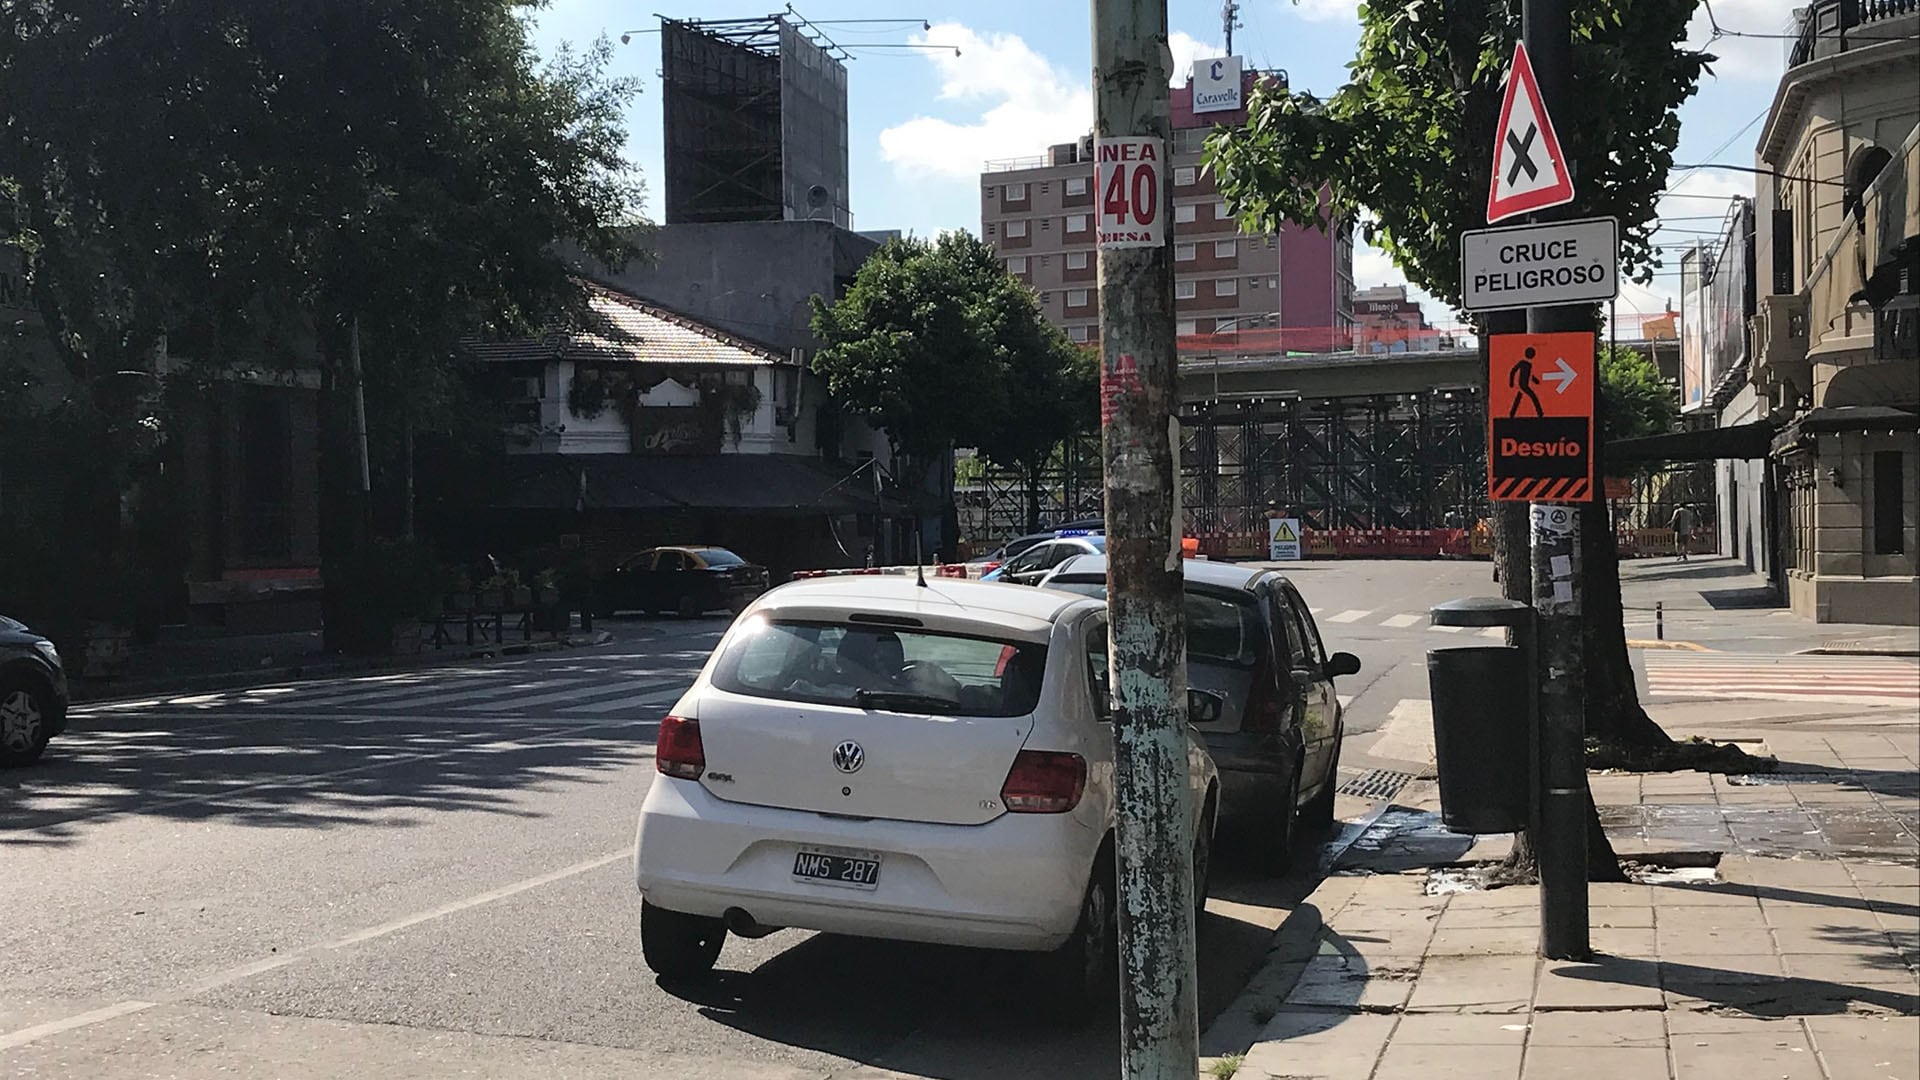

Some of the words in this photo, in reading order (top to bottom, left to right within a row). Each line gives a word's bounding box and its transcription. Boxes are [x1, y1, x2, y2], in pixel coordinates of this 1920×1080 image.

[1196, 88, 1238, 105] Caravelle
[1097, 143, 1157, 163] INEA
[1500, 239, 1578, 265] CRUCE
[1474, 264, 1605, 293] PELIGROSO
[1501, 436, 1581, 457] Desvío
[796, 854, 832, 877] NMS
[841, 860, 878, 882] 287
